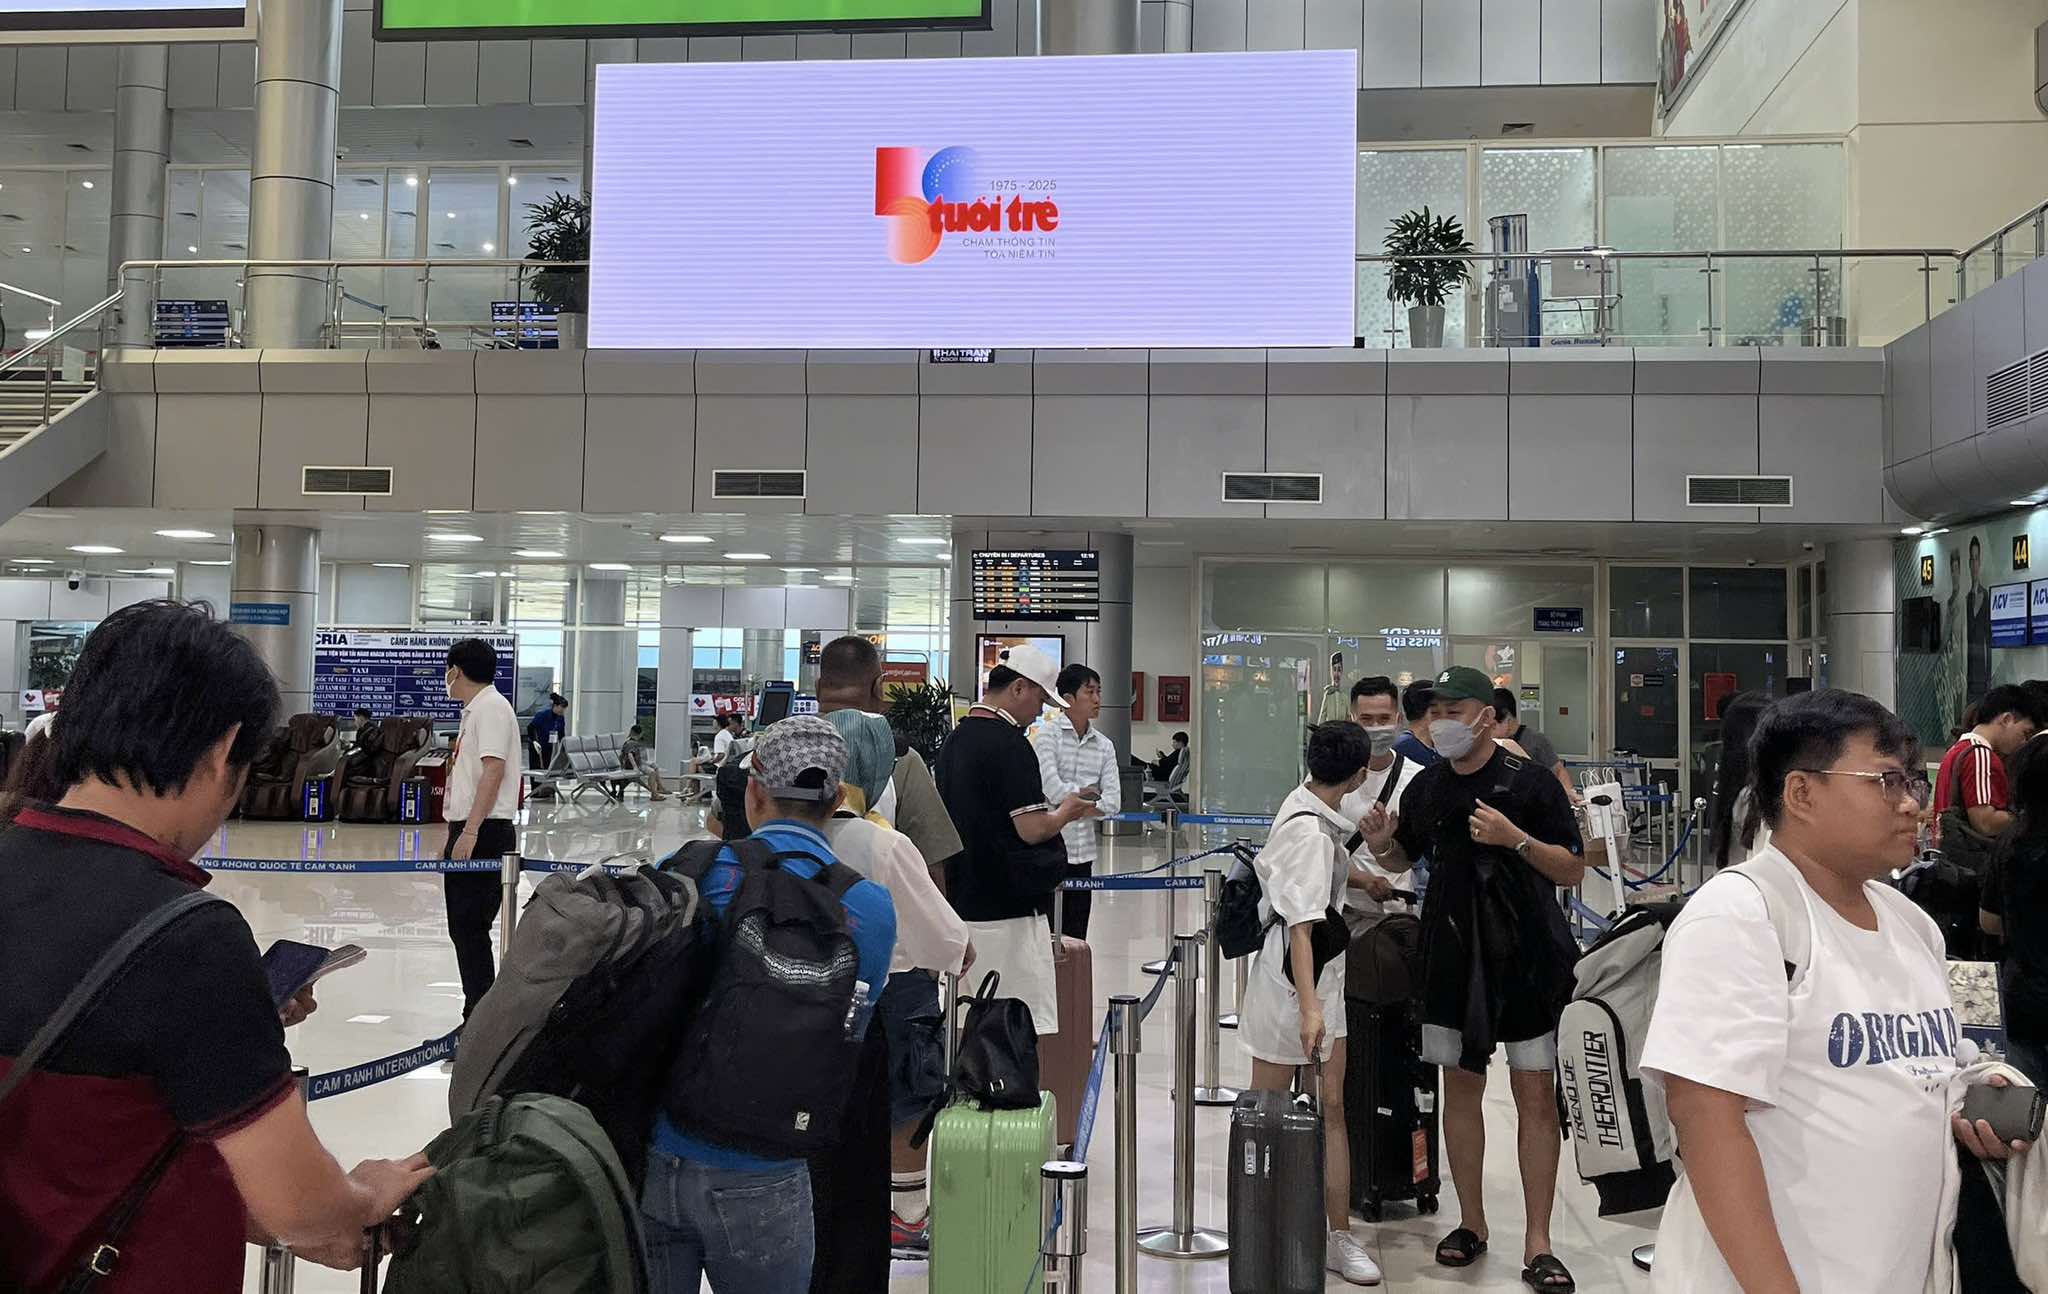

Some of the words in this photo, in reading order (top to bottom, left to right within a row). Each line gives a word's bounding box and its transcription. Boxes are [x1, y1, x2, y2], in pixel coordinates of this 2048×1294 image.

[991, 179, 1017, 191] 1975
[1028, 179, 1057, 191] 2025
[1040, 238, 1056, 247] TIN
[1040, 249, 1056, 259] TIN
[2014, 539, 2028, 565] 44
[1922, 558, 1932, 581] 45
[1992, 594, 2009, 610] ACV
[304, 862, 326, 870] CAM
[328, 862, 356, 871] RANH
[415, 861, 437, 870] CAM
[440, 861, 467, 870] RANH
[469, 861, 502, 869] INTERN
[1075, 880, 1104, 889] RANH
[1165, 878, 1187, 887] CAM
[1190, 878, 1204, 887] RA
[314, 1077, 341, 1094] CAM
[344, 1069, 373, 1088] RANH
[375, 1043, 450, 1078] INTERNATIONAL
